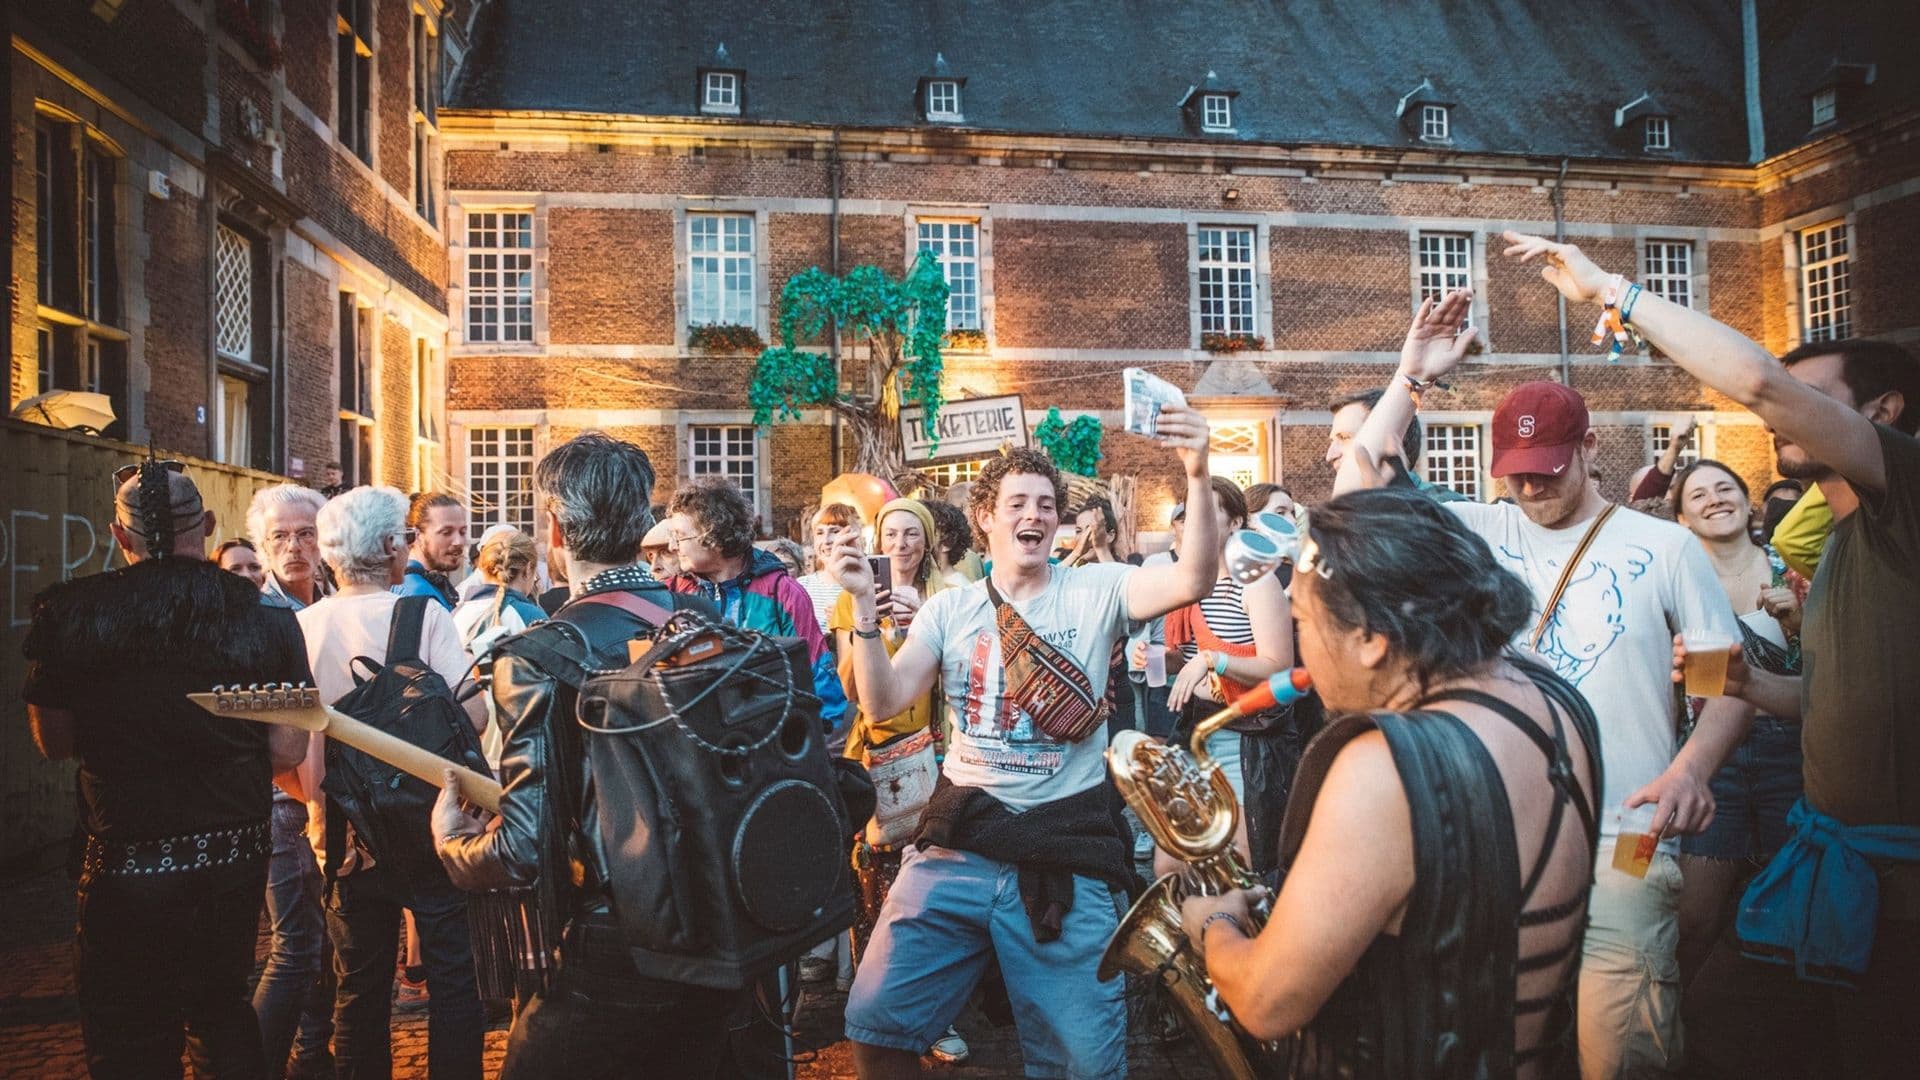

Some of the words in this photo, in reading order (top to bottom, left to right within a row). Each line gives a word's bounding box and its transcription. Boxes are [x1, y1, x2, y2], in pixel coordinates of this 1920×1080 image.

[197, 405, 206, 424] 3
[906, 407, 1015, 442] TIKETERIE
[1518, 415, 1535, 437] S
